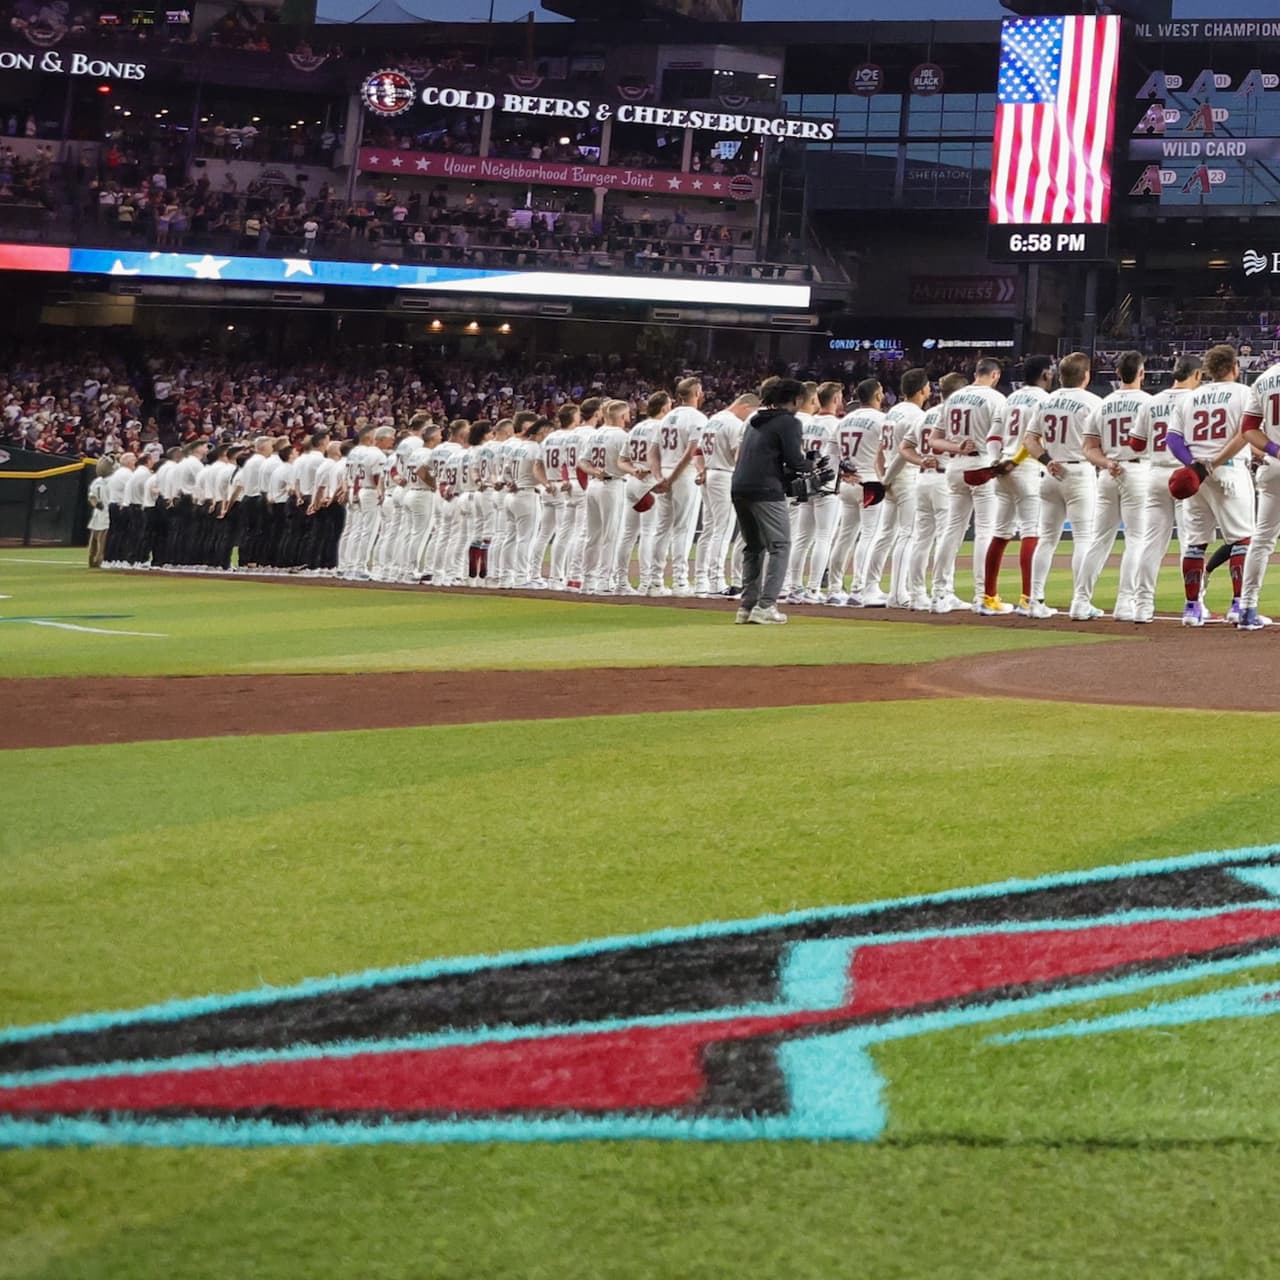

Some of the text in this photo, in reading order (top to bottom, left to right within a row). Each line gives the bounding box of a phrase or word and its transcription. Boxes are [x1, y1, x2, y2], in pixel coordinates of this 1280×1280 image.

[1135, 24, 1152, 37] NL
[1158, 23, 1199, 37] WEST
[40, 52, 64, 72] &
[422, 87, 834, 139] COLD BEERS & CHEESEBURGERS
[1163, 141, 1246, 157] WILD CARD
[444, 158, 654, 188] Your Neighborhood Burger Joint
[1010, 234, 1085, 251] 6:58 PM
[1193, 392, 1232, 405] NAYLOR
[951, 408, 971, 436] 81
[1010, 409, 1020, 436] 2
[1044, 415, 1068, 444] 31
[1107, 417, 1133, 448] 15
[1193, 408, 1226, 439] 22
[661, 428, 678, 450] 33
[841, 432, 863, 457] 57
[545, 448, 560, 469] 18
[630, 440, 647, 462] 32
